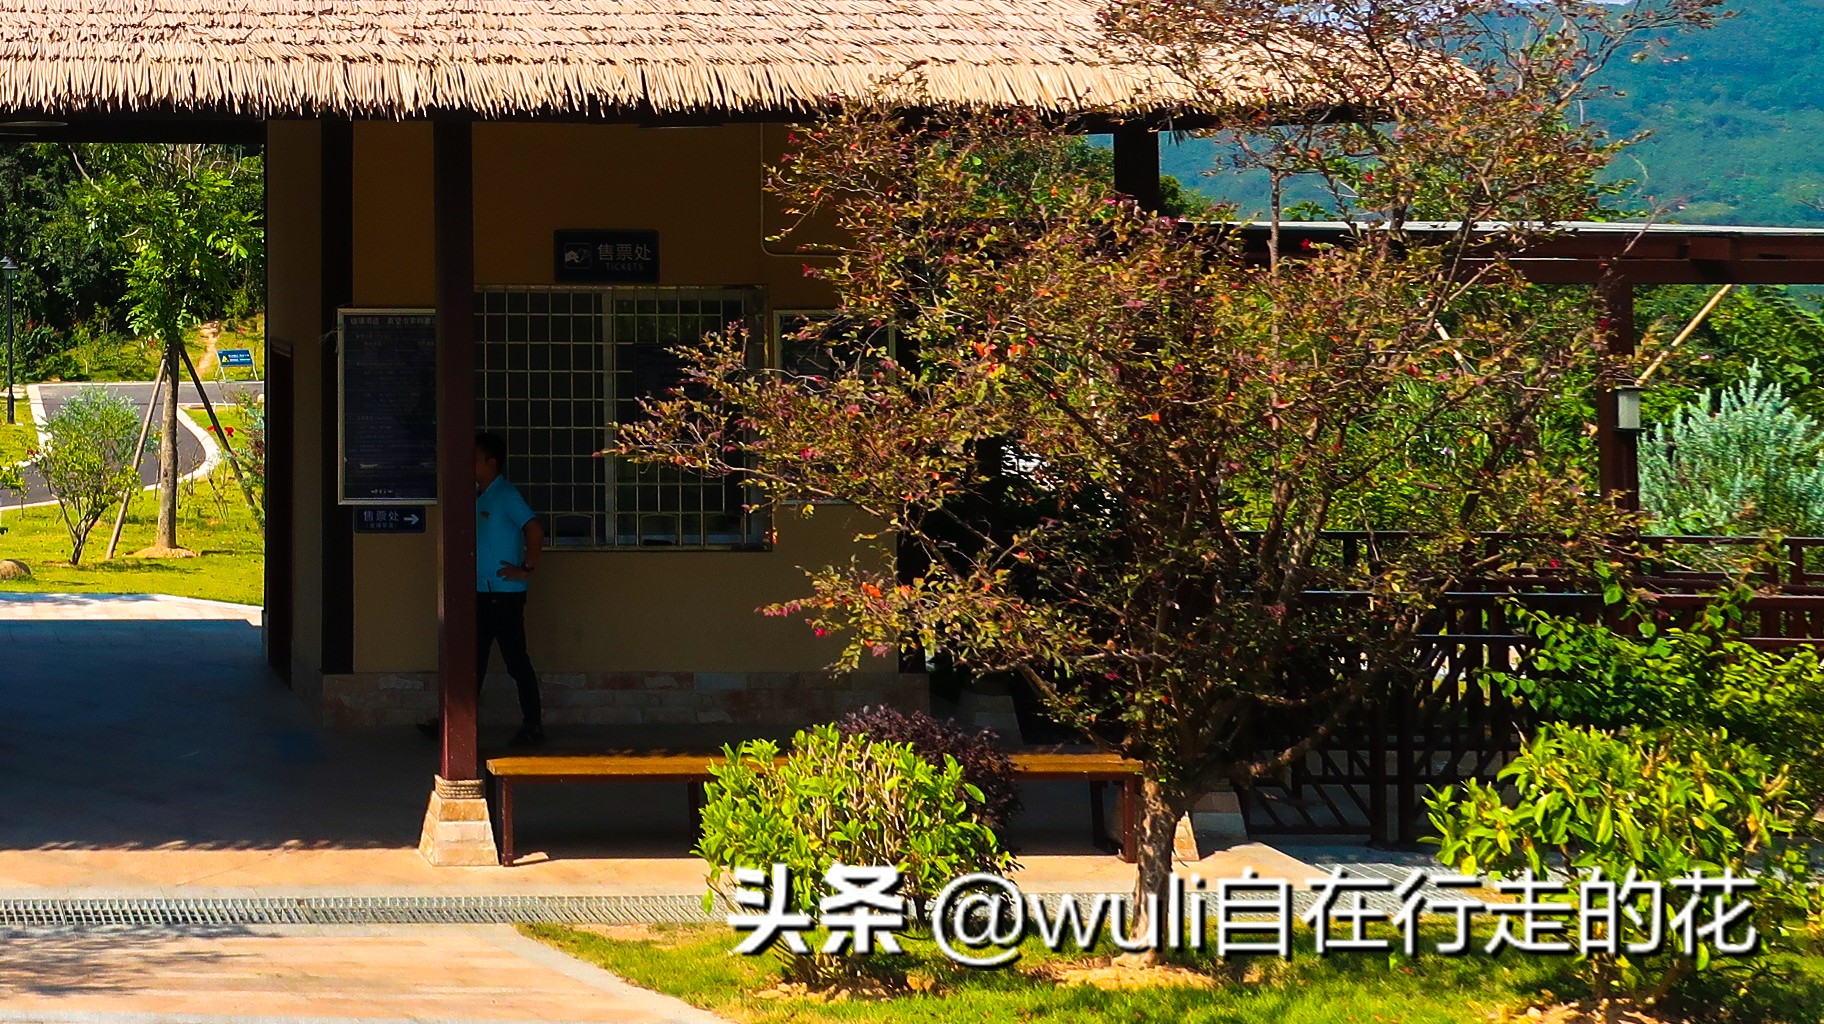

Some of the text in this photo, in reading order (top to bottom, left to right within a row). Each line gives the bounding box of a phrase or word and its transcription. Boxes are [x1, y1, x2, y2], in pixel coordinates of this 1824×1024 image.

[597, 243, 652, 261] 售票处
[605, 262, 645, 271] TICKETS
[363, 510, 399, 521] 售票处
